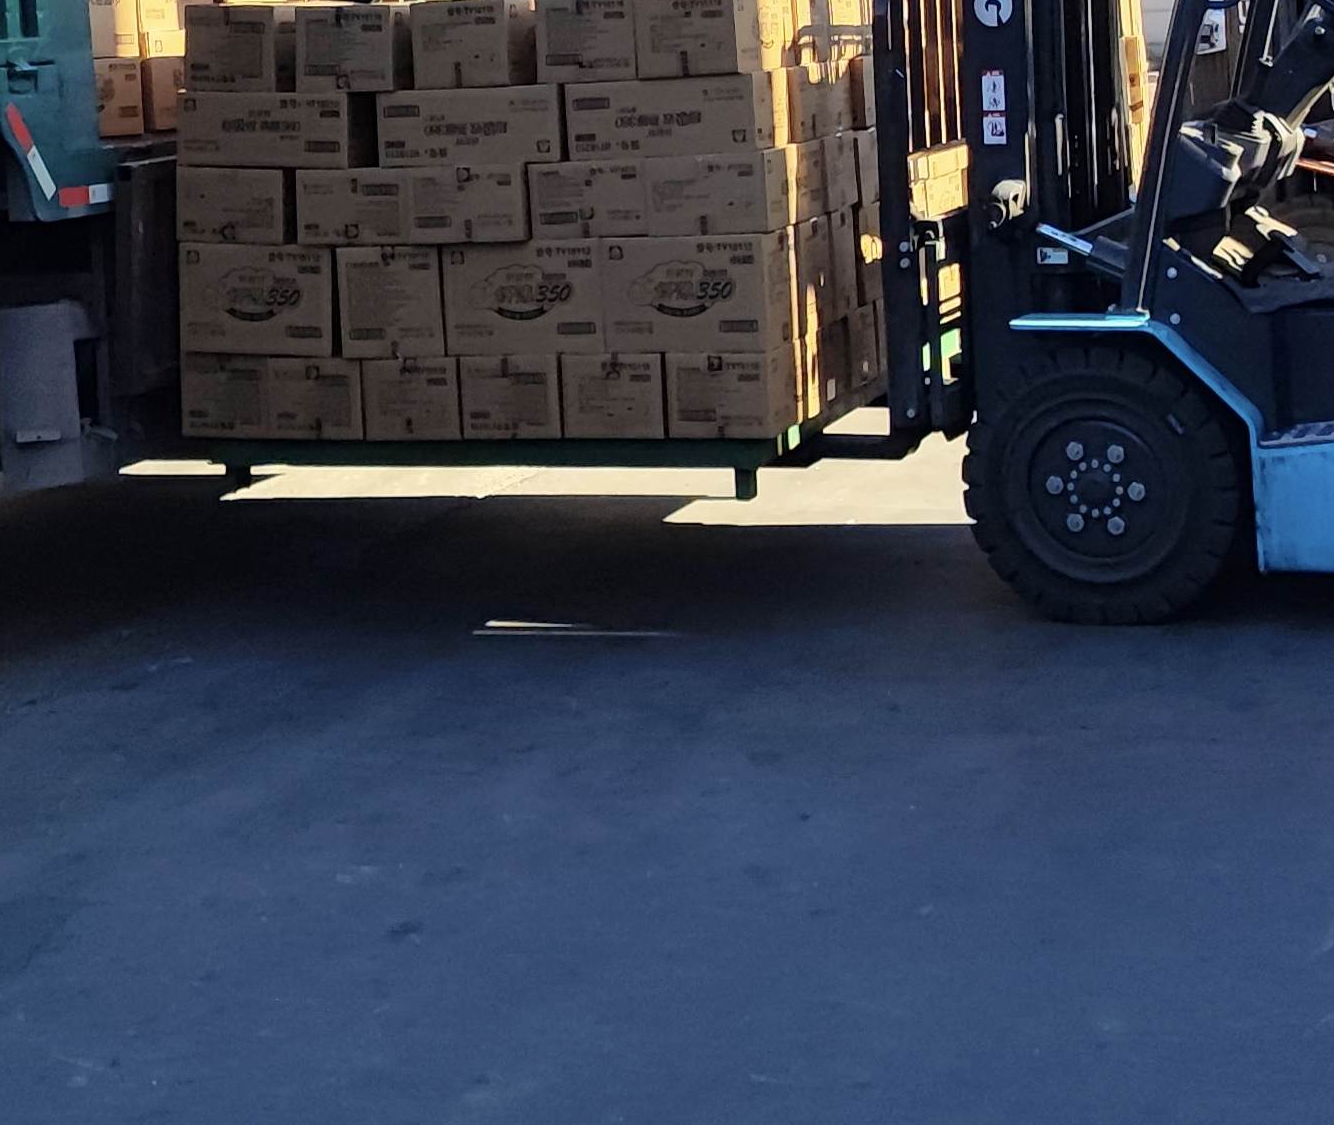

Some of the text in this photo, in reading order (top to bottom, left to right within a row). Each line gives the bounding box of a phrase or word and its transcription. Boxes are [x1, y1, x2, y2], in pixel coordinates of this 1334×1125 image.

[266, 288, 301, 307] 350
[536, 281, 573, 303] 350
[696, 281, 733, 301] 350
